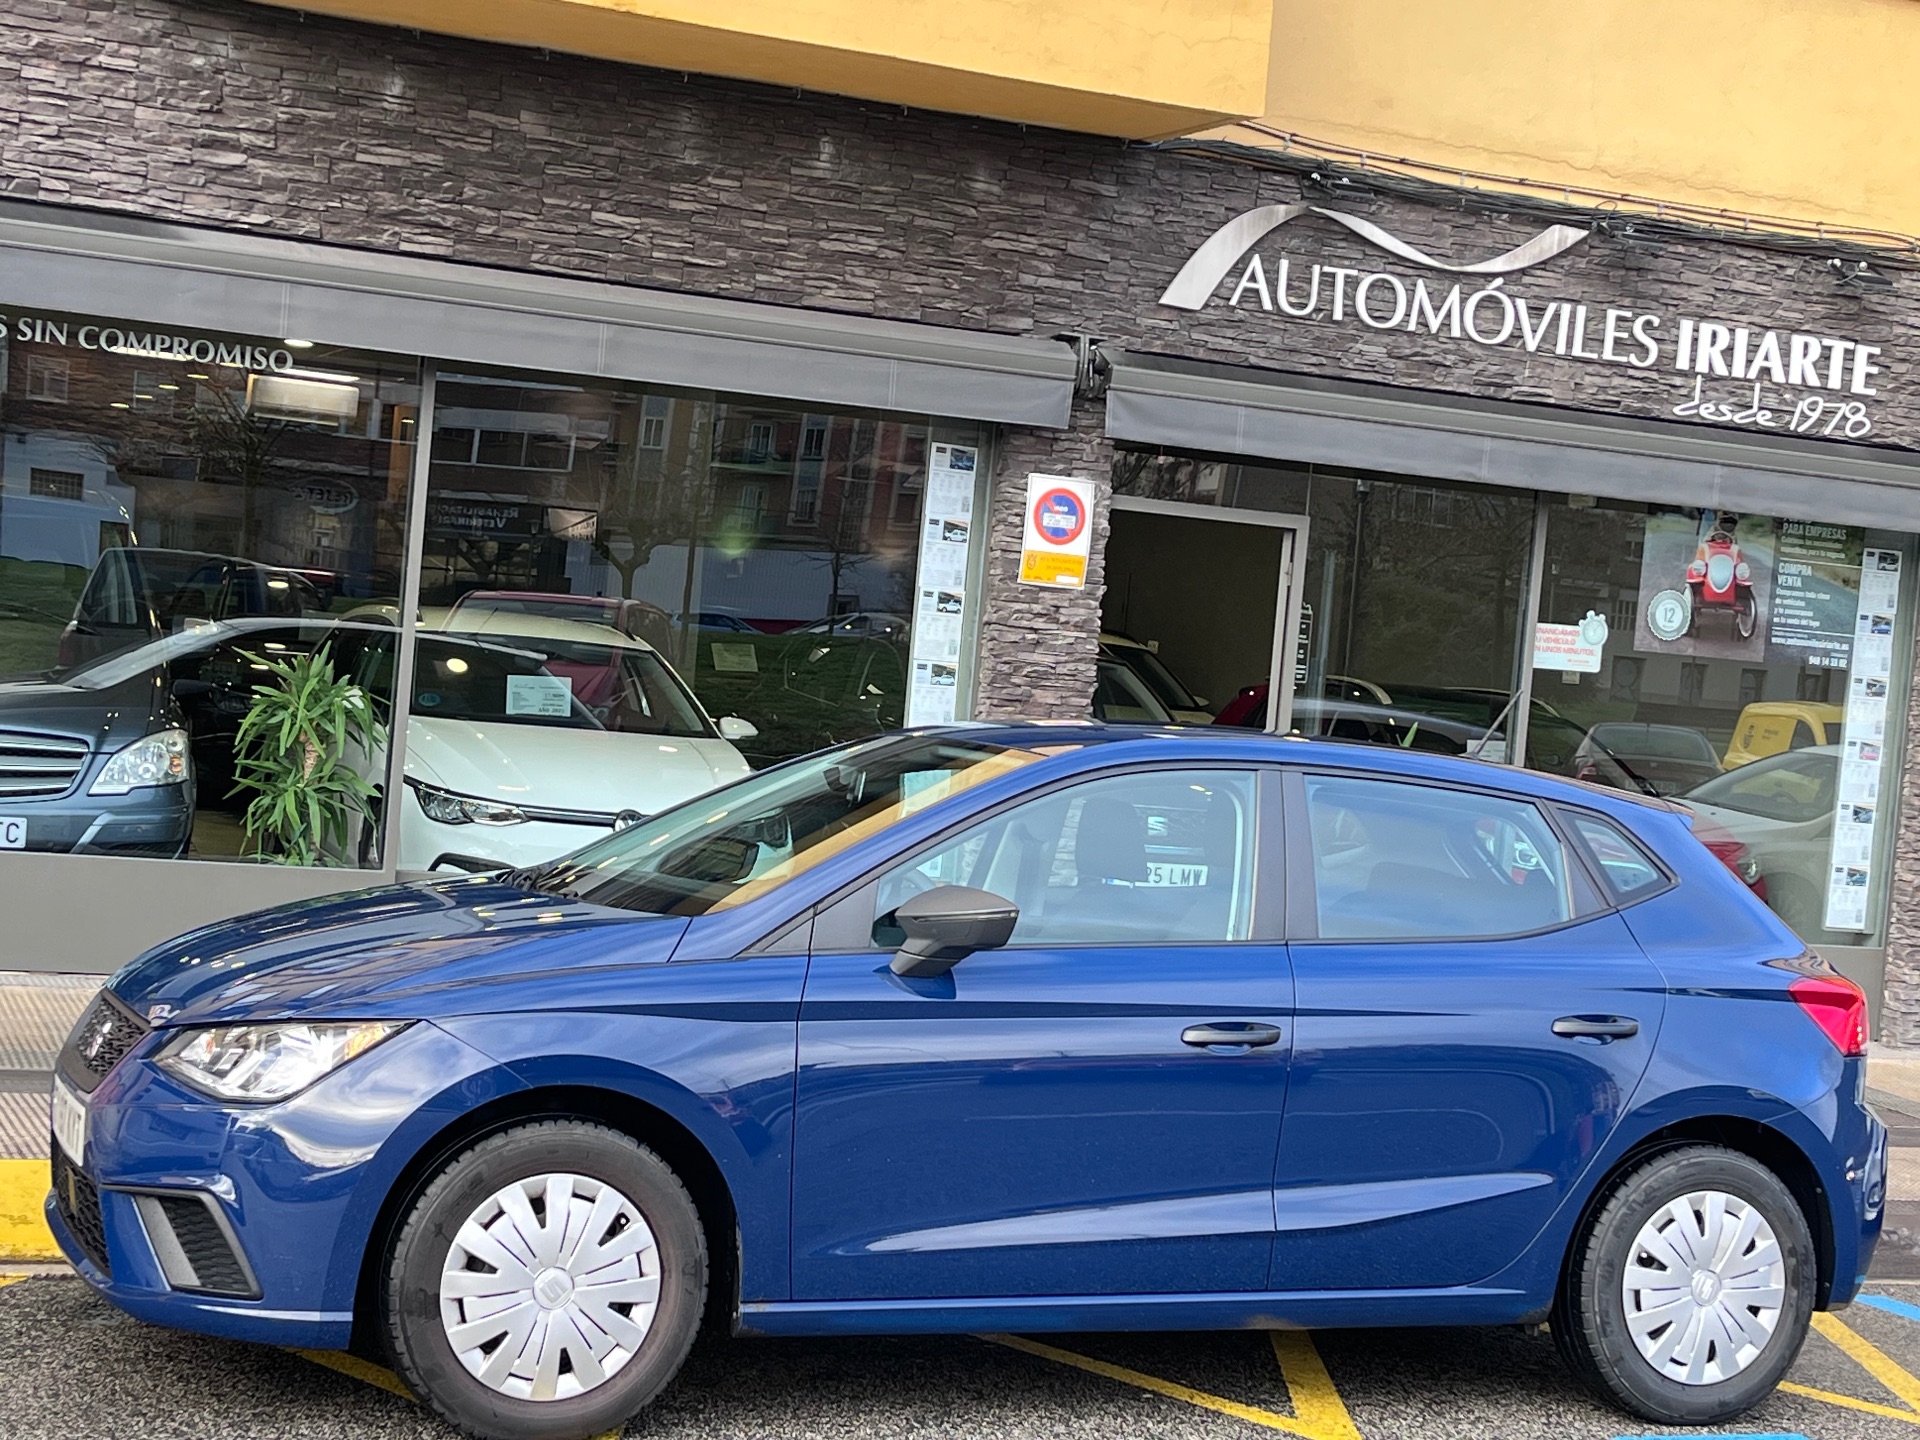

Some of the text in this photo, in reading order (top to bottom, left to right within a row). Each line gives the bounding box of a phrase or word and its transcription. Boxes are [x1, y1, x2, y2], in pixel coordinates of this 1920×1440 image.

[1229, 253, 1881, 396] AUTOMÓVILES IRIARTE
[16, 317, 68, 346] SIN
[77, 325, 294, 372] COMPROMISO
[1672, 374, 1871, 438] desde 1978
[1783, 522, 1847, 540] PARA EMPRESAS
[1778, 562, 1812, 577] COMPRA
[1777, 574, 1802, 588] VENTA
[1663, 607, 1676, 623] 12
[1536, 627, 1581, 637] INANCIAMOS
[0, 821, 20, 843] C
[1169, 867, 1203, 886] LMW
